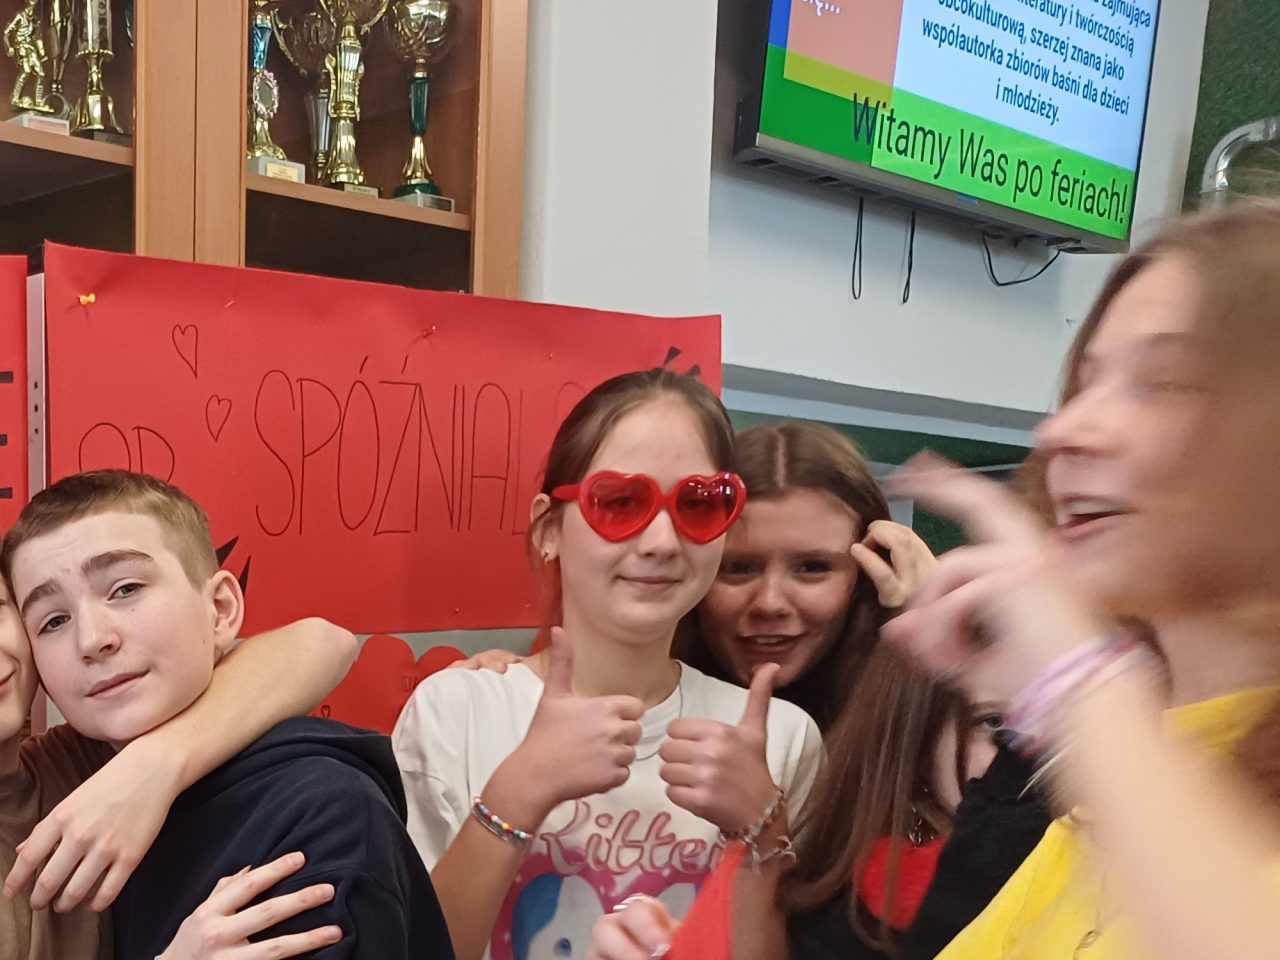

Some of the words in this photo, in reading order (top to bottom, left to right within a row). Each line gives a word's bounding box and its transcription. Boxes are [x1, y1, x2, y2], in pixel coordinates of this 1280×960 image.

[1017, 0, 1068, 27] eratury
[1075, 8, 1135, 58] twórczością
[1030, 27, 1070, 63] szerzej
[1070, 44, 1102, 72] znana
[1101, 53, 1125, 81] jako
[922, 18, 1004, 66] współautorka
[1006, 48, 1051, 84] zbiorów
[1051, 65, 1082, 97] baśni
[1082, 79, 1098, 103] dla
[1100, 86, 1131, 116] dzieci
[995, 77, 1001, 100] i
[1002, 84, 1060, 127] młodzieży.
[853, 92, 952, 180] Witamy
[959, 128, 1009, 187] Was
[1013, 157, 1043, 203] po
[1049, 158, 1128, 224] feriach!
